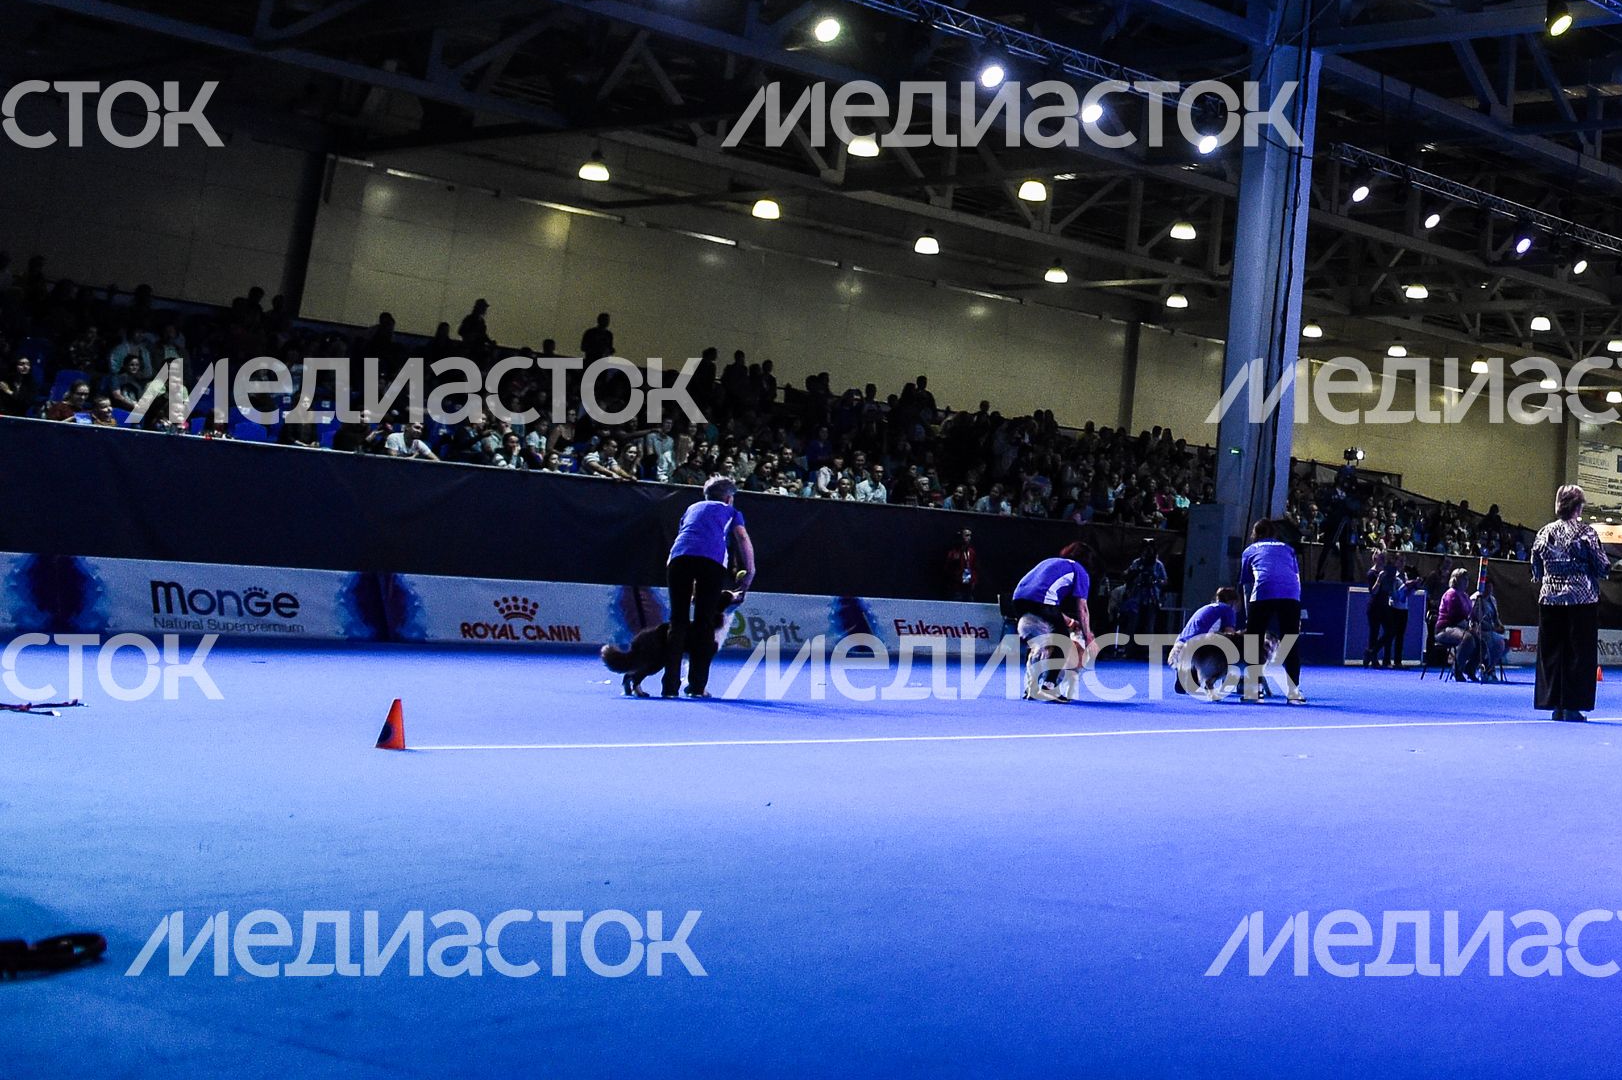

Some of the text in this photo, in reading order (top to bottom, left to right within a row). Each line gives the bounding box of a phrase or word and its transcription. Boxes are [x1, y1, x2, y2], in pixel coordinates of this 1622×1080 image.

[153, 617, 304, 633] Natural Superpremium
[460, 620, 581, 643] ROYAL CANIN
[748, 616, 801, 643] Brit
[893, 618, 990, 639] Eukanuba
